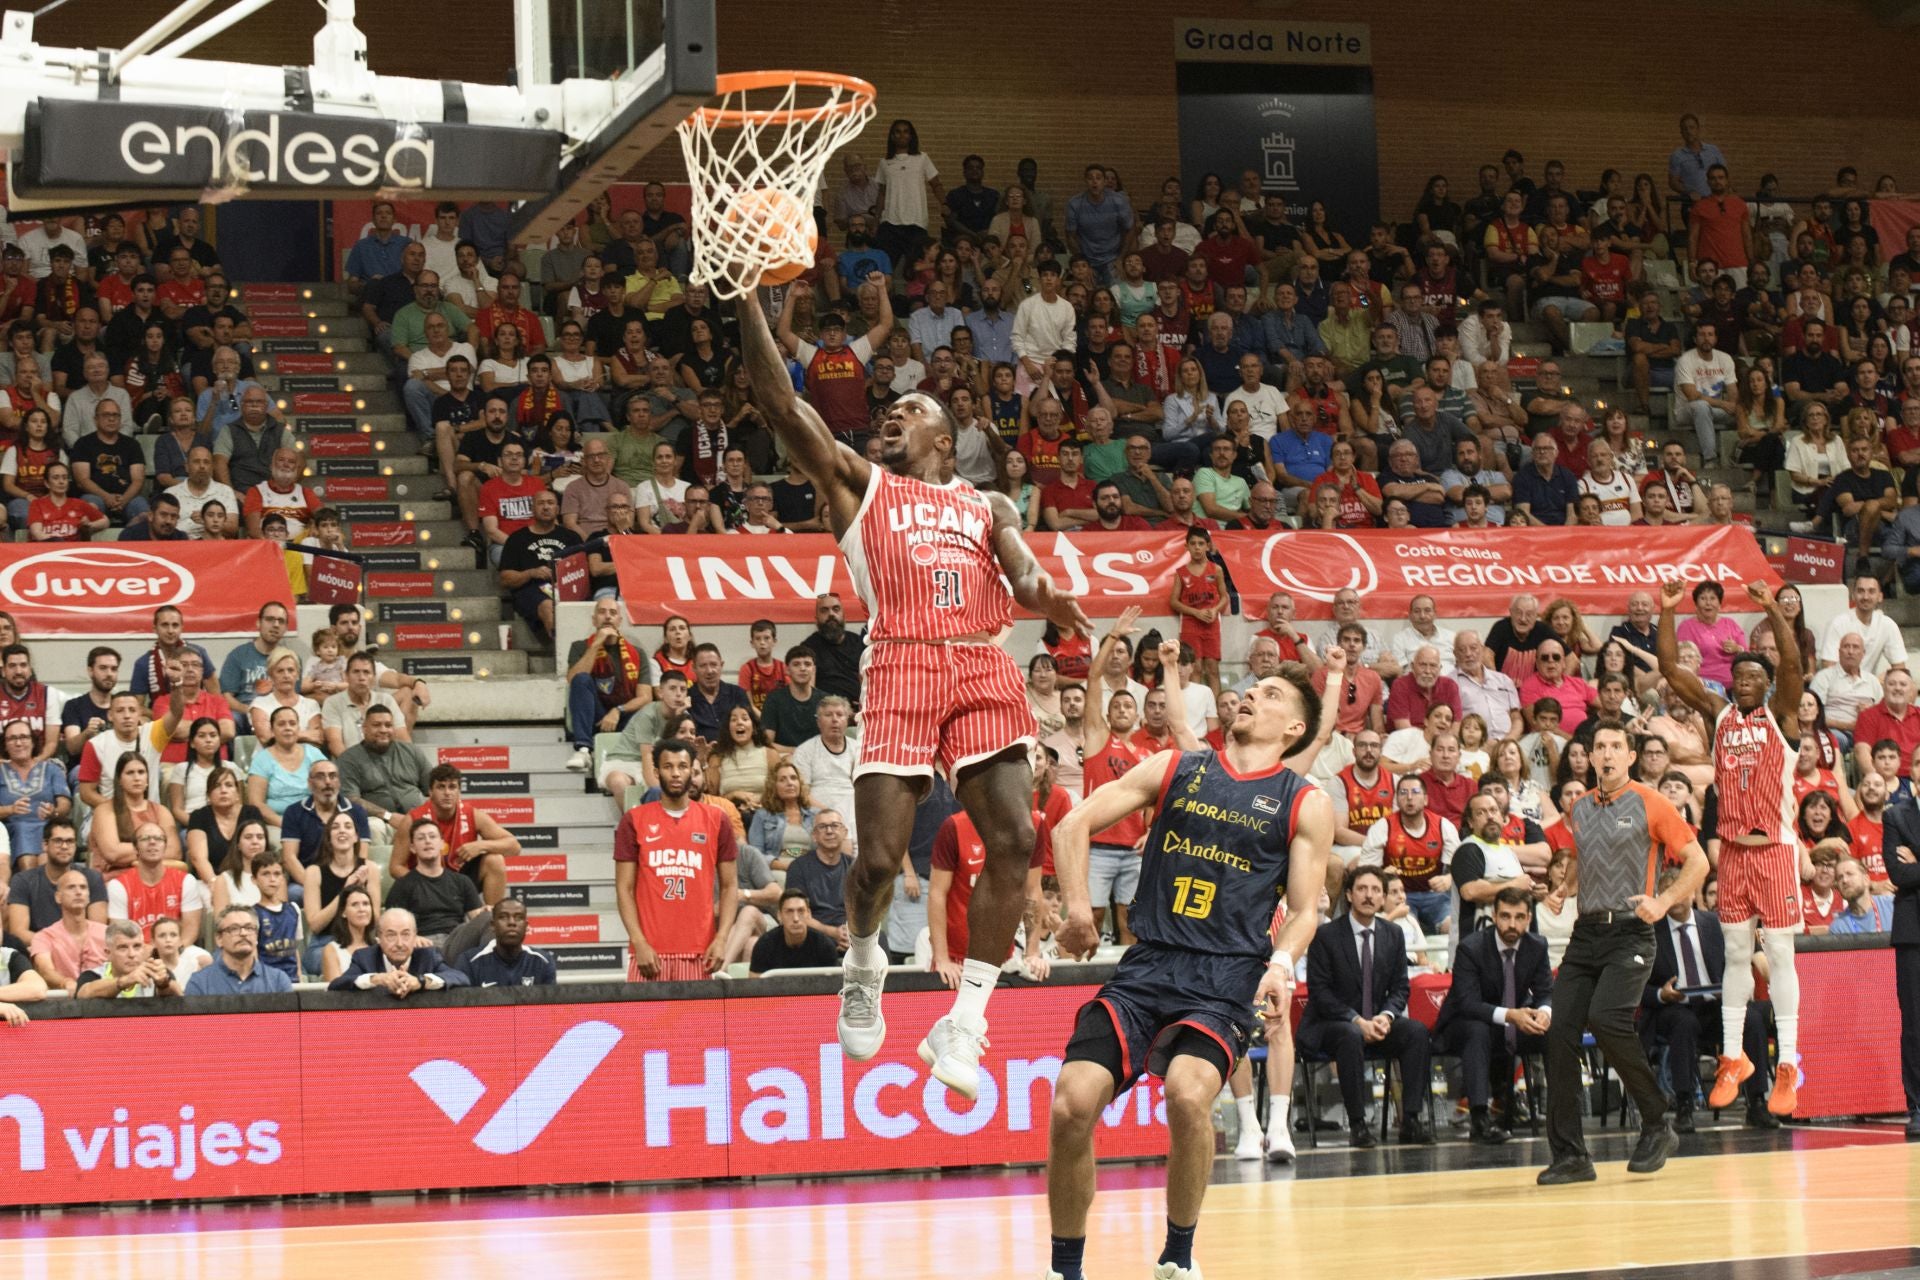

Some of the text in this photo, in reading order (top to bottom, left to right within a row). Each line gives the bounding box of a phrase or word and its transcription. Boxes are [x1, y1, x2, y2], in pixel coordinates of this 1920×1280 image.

[1185, 27, 1361, 53] Grada Norte
[120, 114, 435, 188] endesa
[817, 361, 855, 373] UCAM
[888, 503, 987, 545] UCAM
[1395, 543, 1503, 561] Costa Cálida
[1793, 551, 1836, 568] MÓDULO
[23, 572, 170, 597] Juver
[317, 572, 354, 590] MÓDULO
[1401, 562, 1743, 587] REGIÓN DE MURCIA
[331, 588, 338, 598] 7
[932, 568, 963, 608] 31
[1722, 726, 1768, 747] UCAM
[1741, 767, 1750, 791] 1
[1185, 800, 1271, 834] MORABANC
[649, 848, 703, 871] UCAM
[1178, 838, 1251, 873] Andorra
[655, 866, 696, 879] MURCIA
[663, 876, 686, 901] 24
[1172, 876, 1217, 920] 13
[643, 1042, 1065, 1148] Halcon
[62, 1104, 283, 1181] viajes
